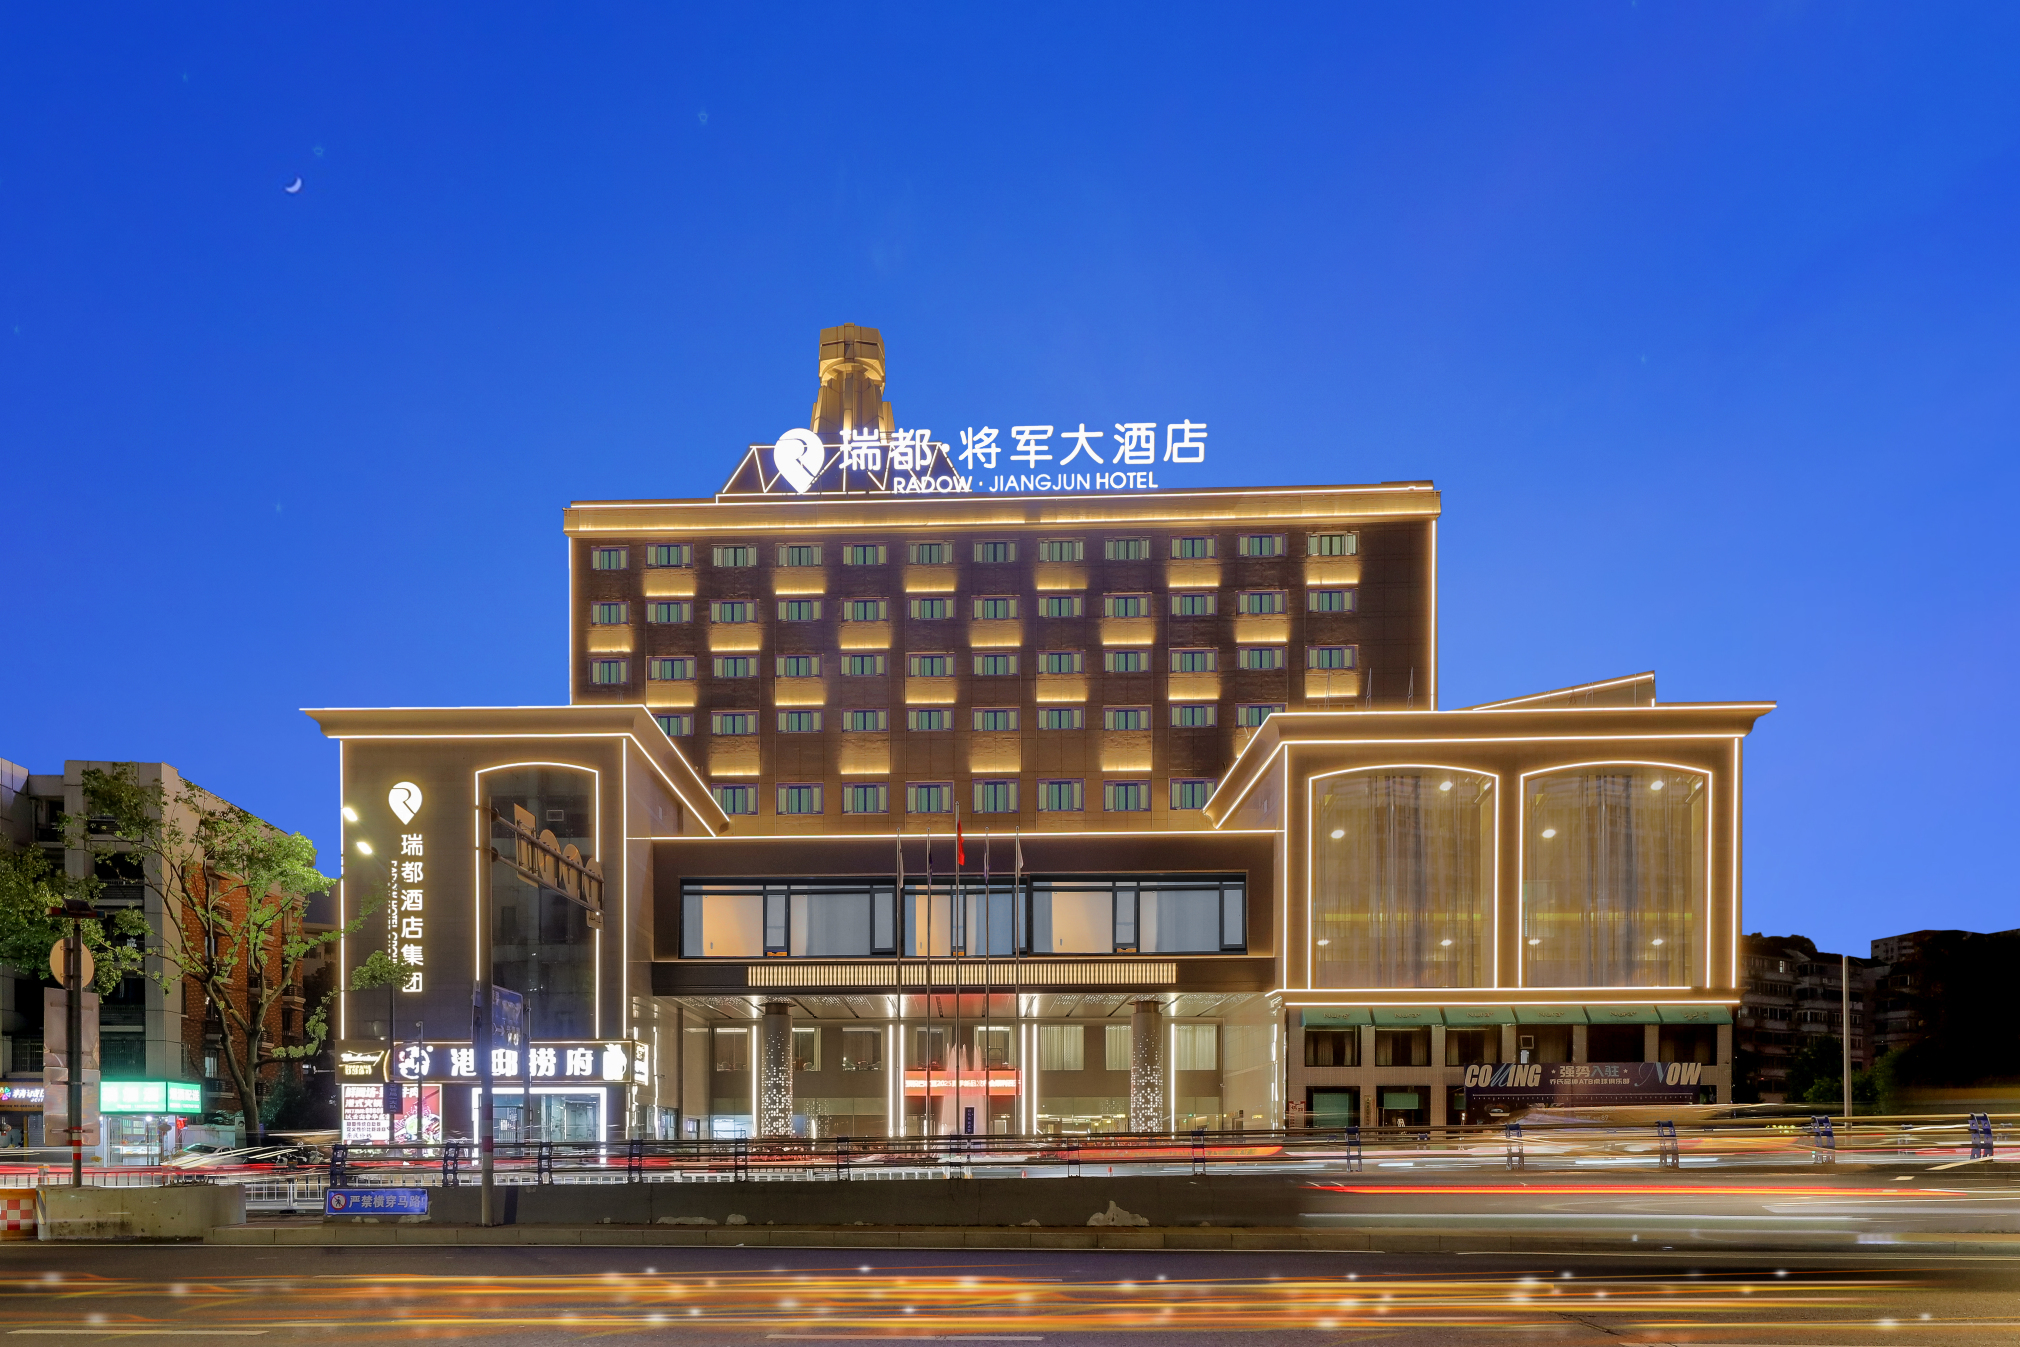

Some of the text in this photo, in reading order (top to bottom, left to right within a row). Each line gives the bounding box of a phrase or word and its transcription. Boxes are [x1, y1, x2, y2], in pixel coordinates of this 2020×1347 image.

[893, 471, 1159, 494] RADOW JIANGJUN HOTEL
[401, 833, 424, 993] 瑞都酒店集团
[1465, 1063, 1541, 1087] COMING
[1559, 1065, 1620, 1078] 强势入驻
[1634, 1062, 1702, 1087] NOW
